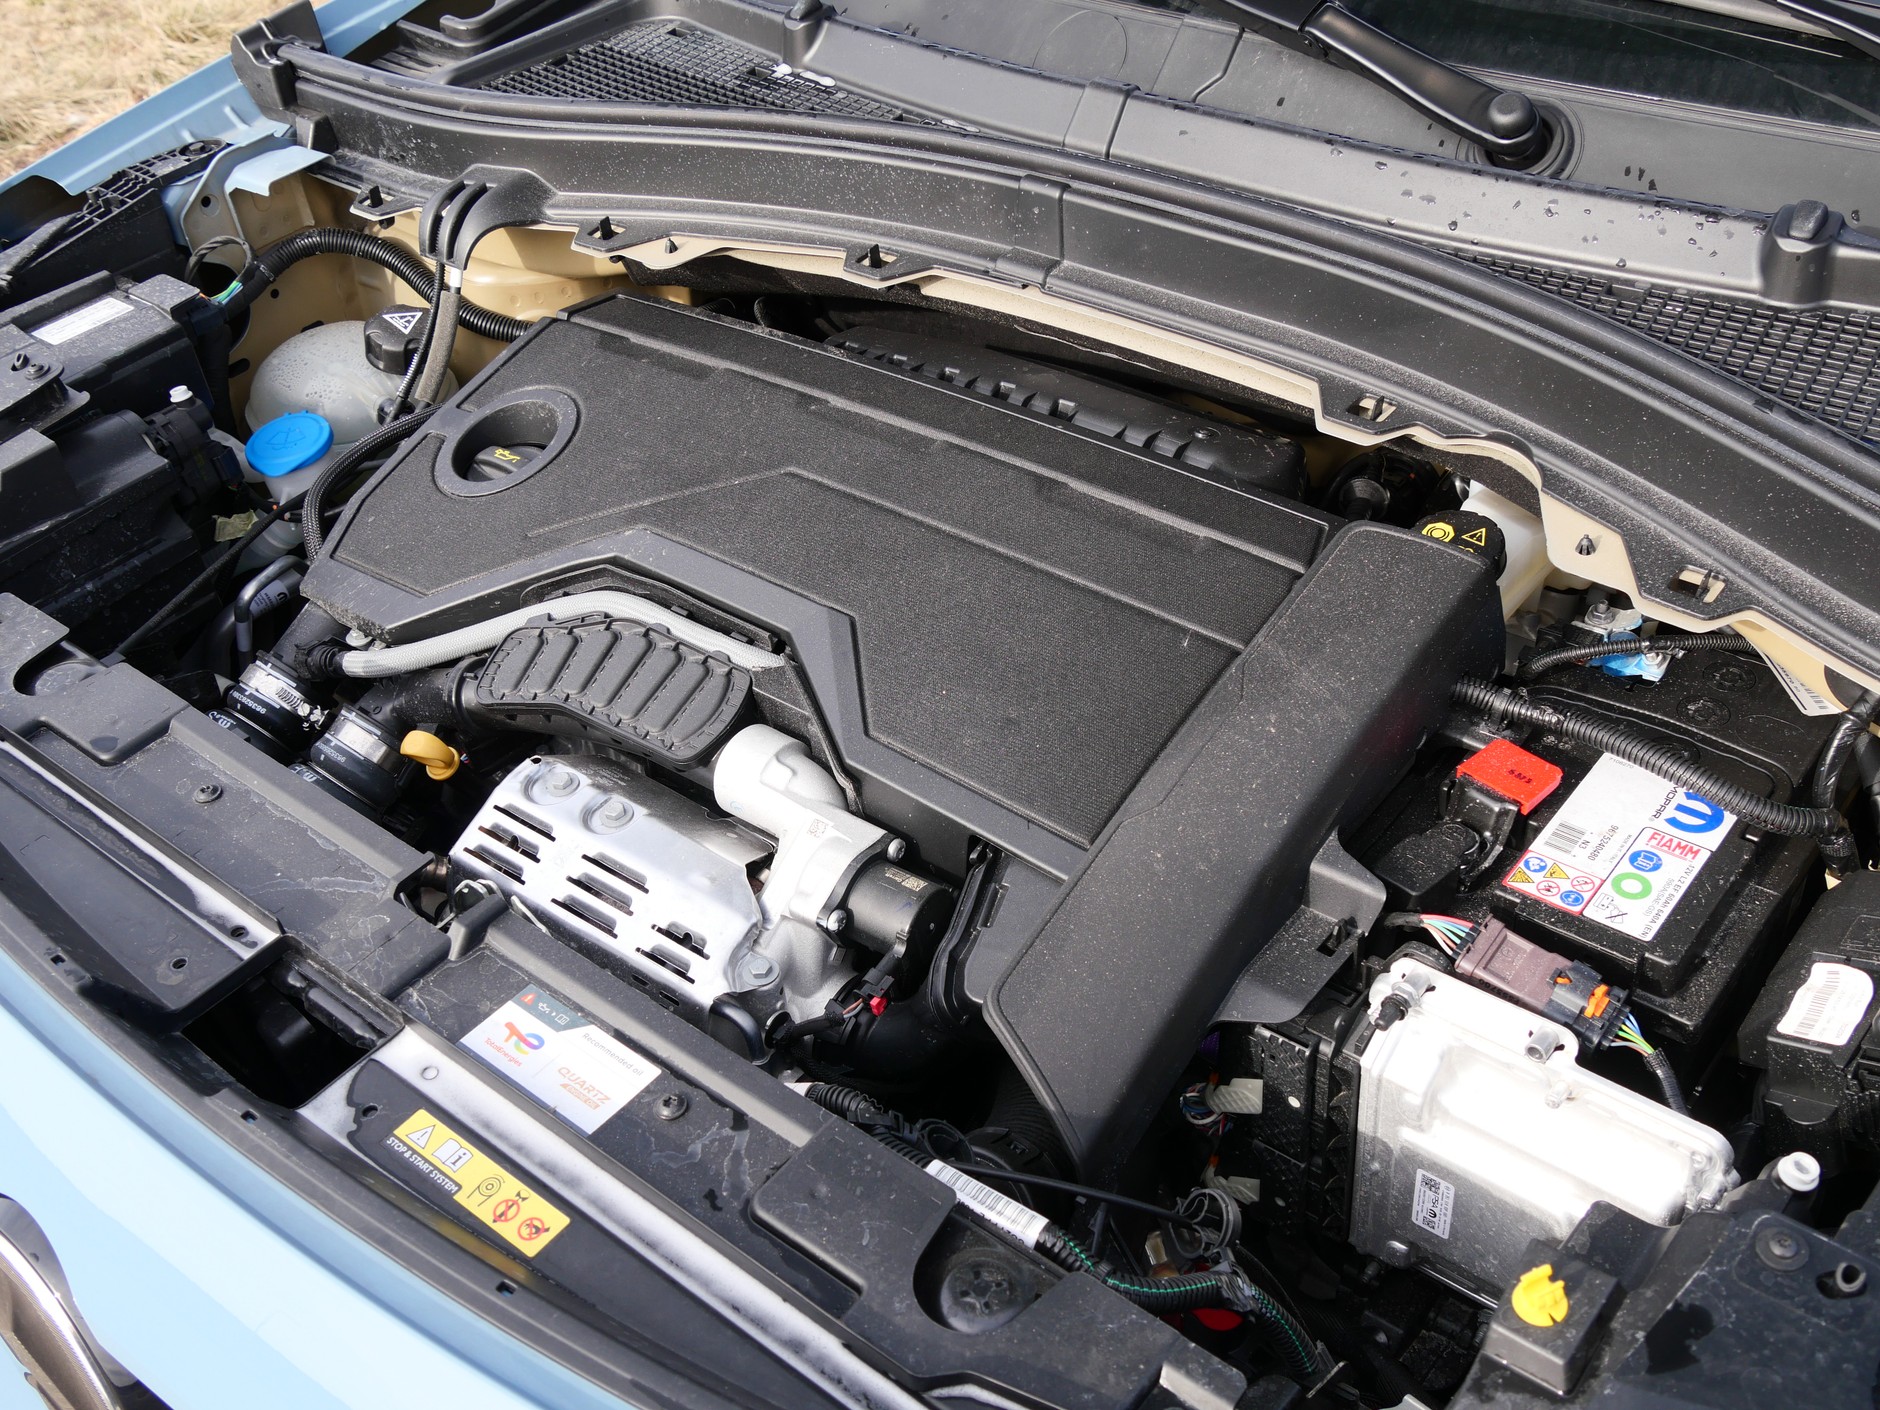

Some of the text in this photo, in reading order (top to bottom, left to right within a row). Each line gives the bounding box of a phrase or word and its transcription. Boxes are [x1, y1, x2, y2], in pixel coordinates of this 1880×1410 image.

[1652, 785, 1680, 819] MOPAR
[1578, 839, 1591, 850] N3
[1588, 824, 1619, 861] 9675240480
[1647, 832, 1702, 861] FIAMM
[1677, 876, 1687, 884] L2
[1684, 865, 1696, 878] 12V
[1674, 884, 1682, 893] EF
[1638, 924, 1654, 939] (EN)
[484, 1037, 523, 1068] TotalEnergies
[582, 1032, 645, 1077] Recommended oil
[557, 1066, 611, 1105] QUARTZ
[386, 1136, 459, 1194] STOP & START SYSTEM
